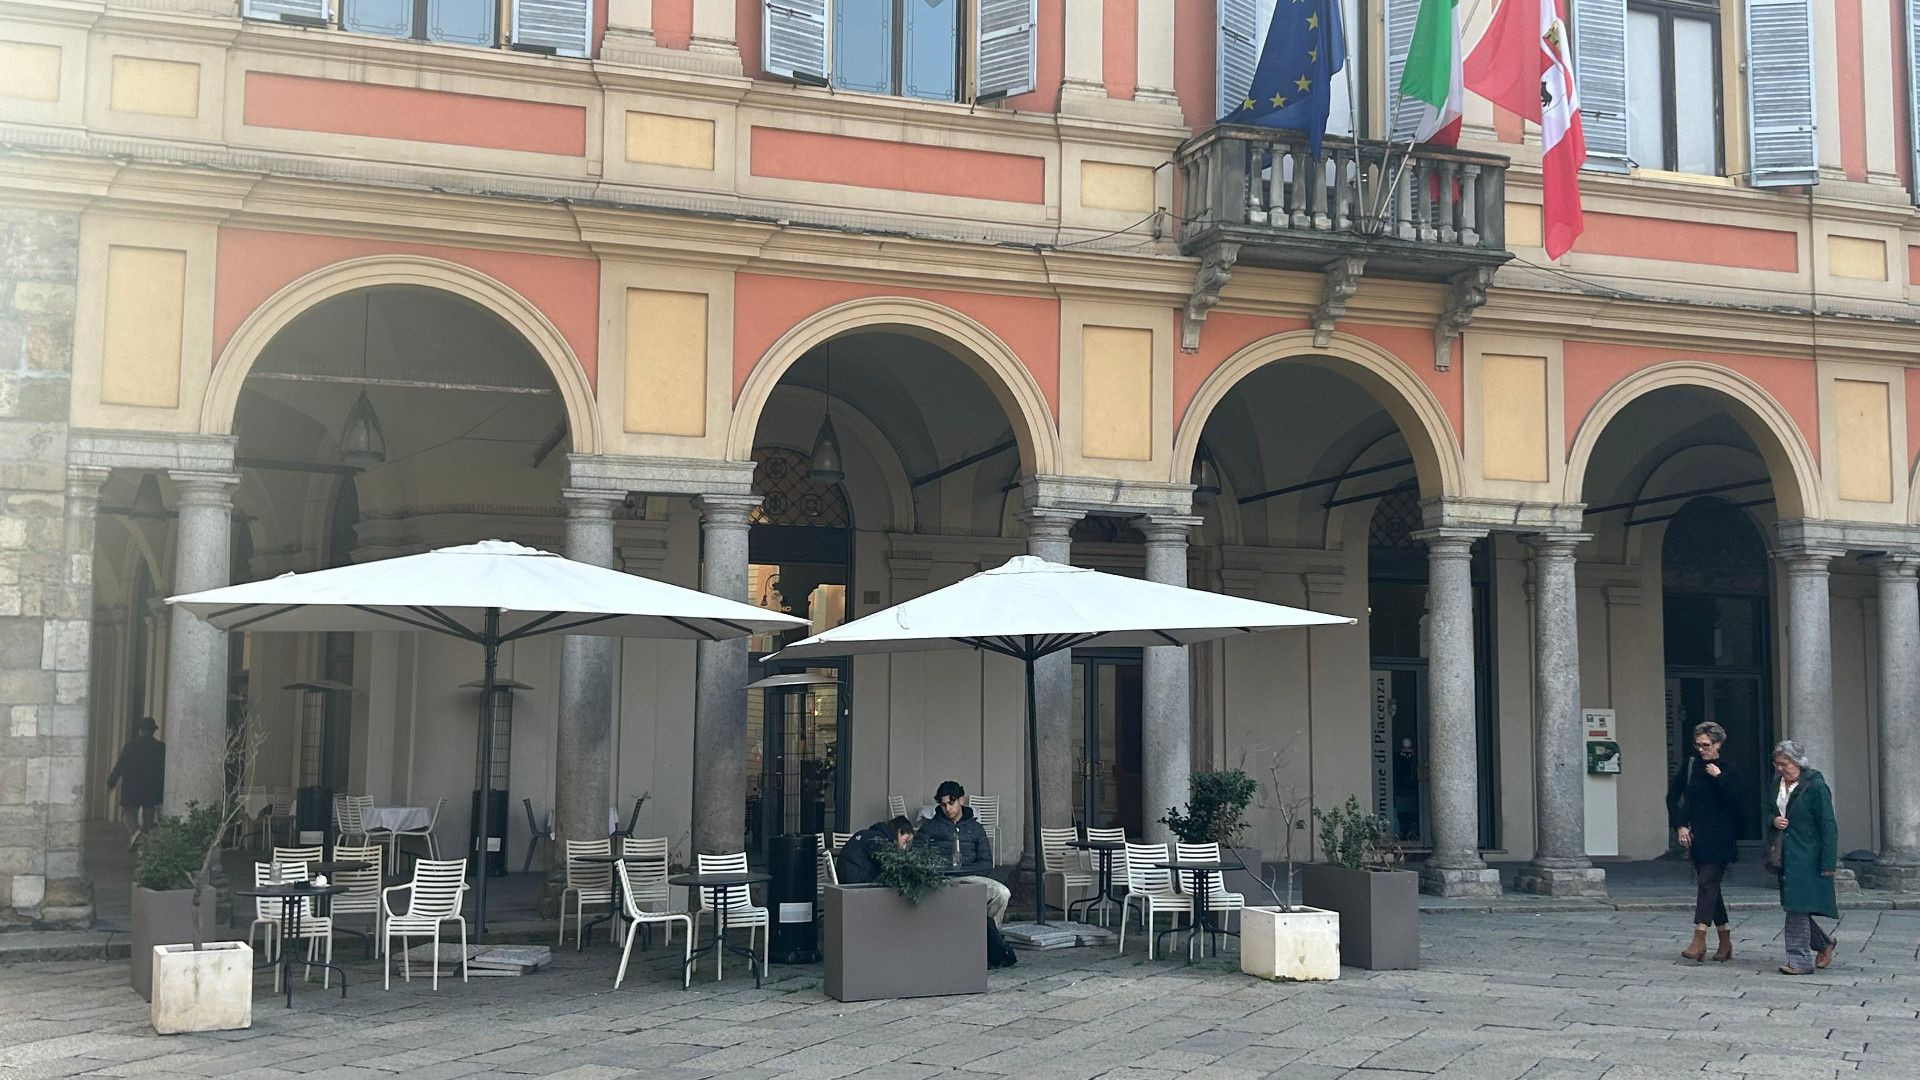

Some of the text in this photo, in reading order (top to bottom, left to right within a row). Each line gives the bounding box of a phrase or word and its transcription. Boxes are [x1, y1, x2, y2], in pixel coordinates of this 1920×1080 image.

[1375, 678, 1387, 833] omune di Piacenza
